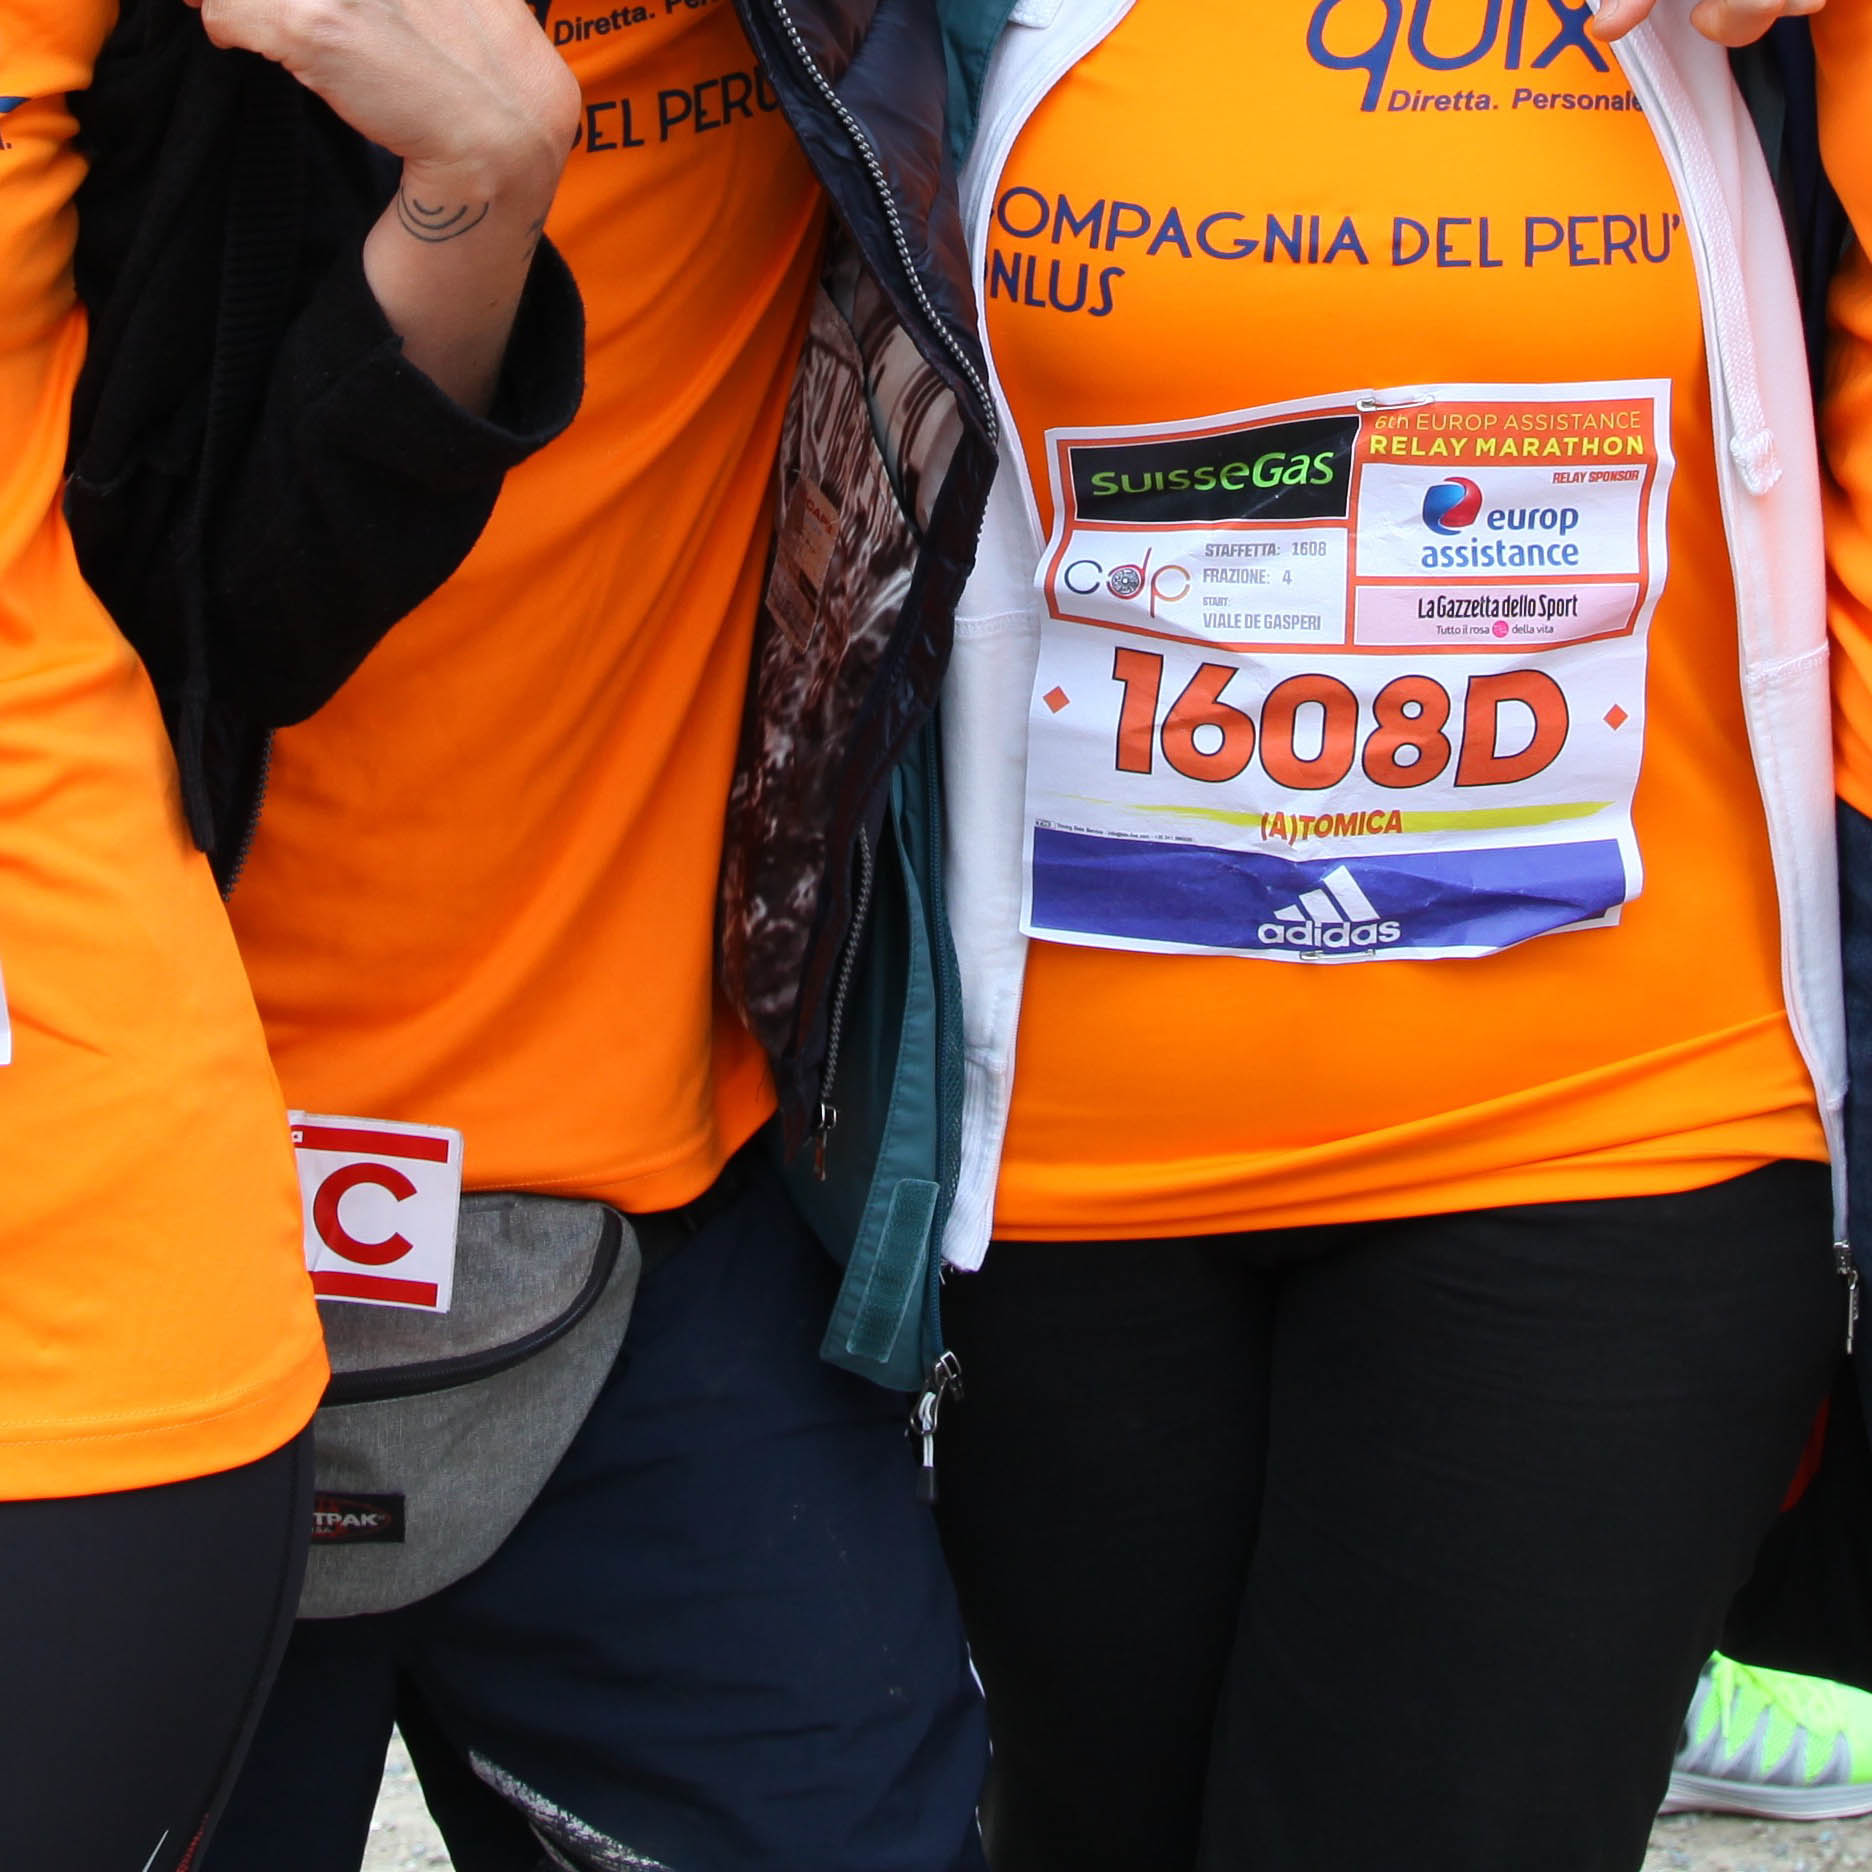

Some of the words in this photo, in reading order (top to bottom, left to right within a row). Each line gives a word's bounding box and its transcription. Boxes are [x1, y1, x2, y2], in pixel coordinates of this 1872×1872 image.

[555, 8, 655, 46] Diretta.
[1386, 88, 1498, 113] Diretta.
[570, 98, 645, 153] EL
[990, 186, 1369, 266] OMPAGNIA
[1393, 216, 1503, 267] DEL
[1524, 214, 1681, 267] PERU'
[984, 249, 1126, 316] NLUS
[1375, 415, 1409, 431] 6th
[1416, 414, 1498, 431] EUROP
[1504, 411, 1640, 430] ASSISTANCE
[1369, 435, 1468, 457] RELAY
[1475, 435, 1644, 457] MARATHON
[1552, 471, 1586, 484] RELAY
[1589, 470, 1639, 483] SPONSOR
[1486, 506, 1579, 535] europ
[1205, 542, 1280, 558] STAFFETTA:
[1291, 541, 1326, 557] 1608
[1421, 536, 1579, 568] assistance
[1203, 568, 1270, 584] FRAZIONE:
[1282, 569, 1293, 584] 4
[1203, 613, 1241, 629] VIALE
[1244, 613, 1262, 629] DE
[1264, 613, 1321, 630] GASPERI
[1418, 598, 1434, 618] La
[1437, 595, 1499, 618] Gazzetta
[1502, 594, 1536, 618] dello
[1538, 594, 1578, 621] Sport
[1436, 625, 1461, 635] Tutto
[1469, 626, 1490, 635] rosa
[1512, 624, 1534, 634] della
[1536, 625, 1554, 634] vita
[1112, 645, 1569, 790] 1608D
[1260, 809, 1403, 846] (A)TOMICA
[1258, 920, 1400, 948] adidas
[313, 1162, 418, 1266] C
